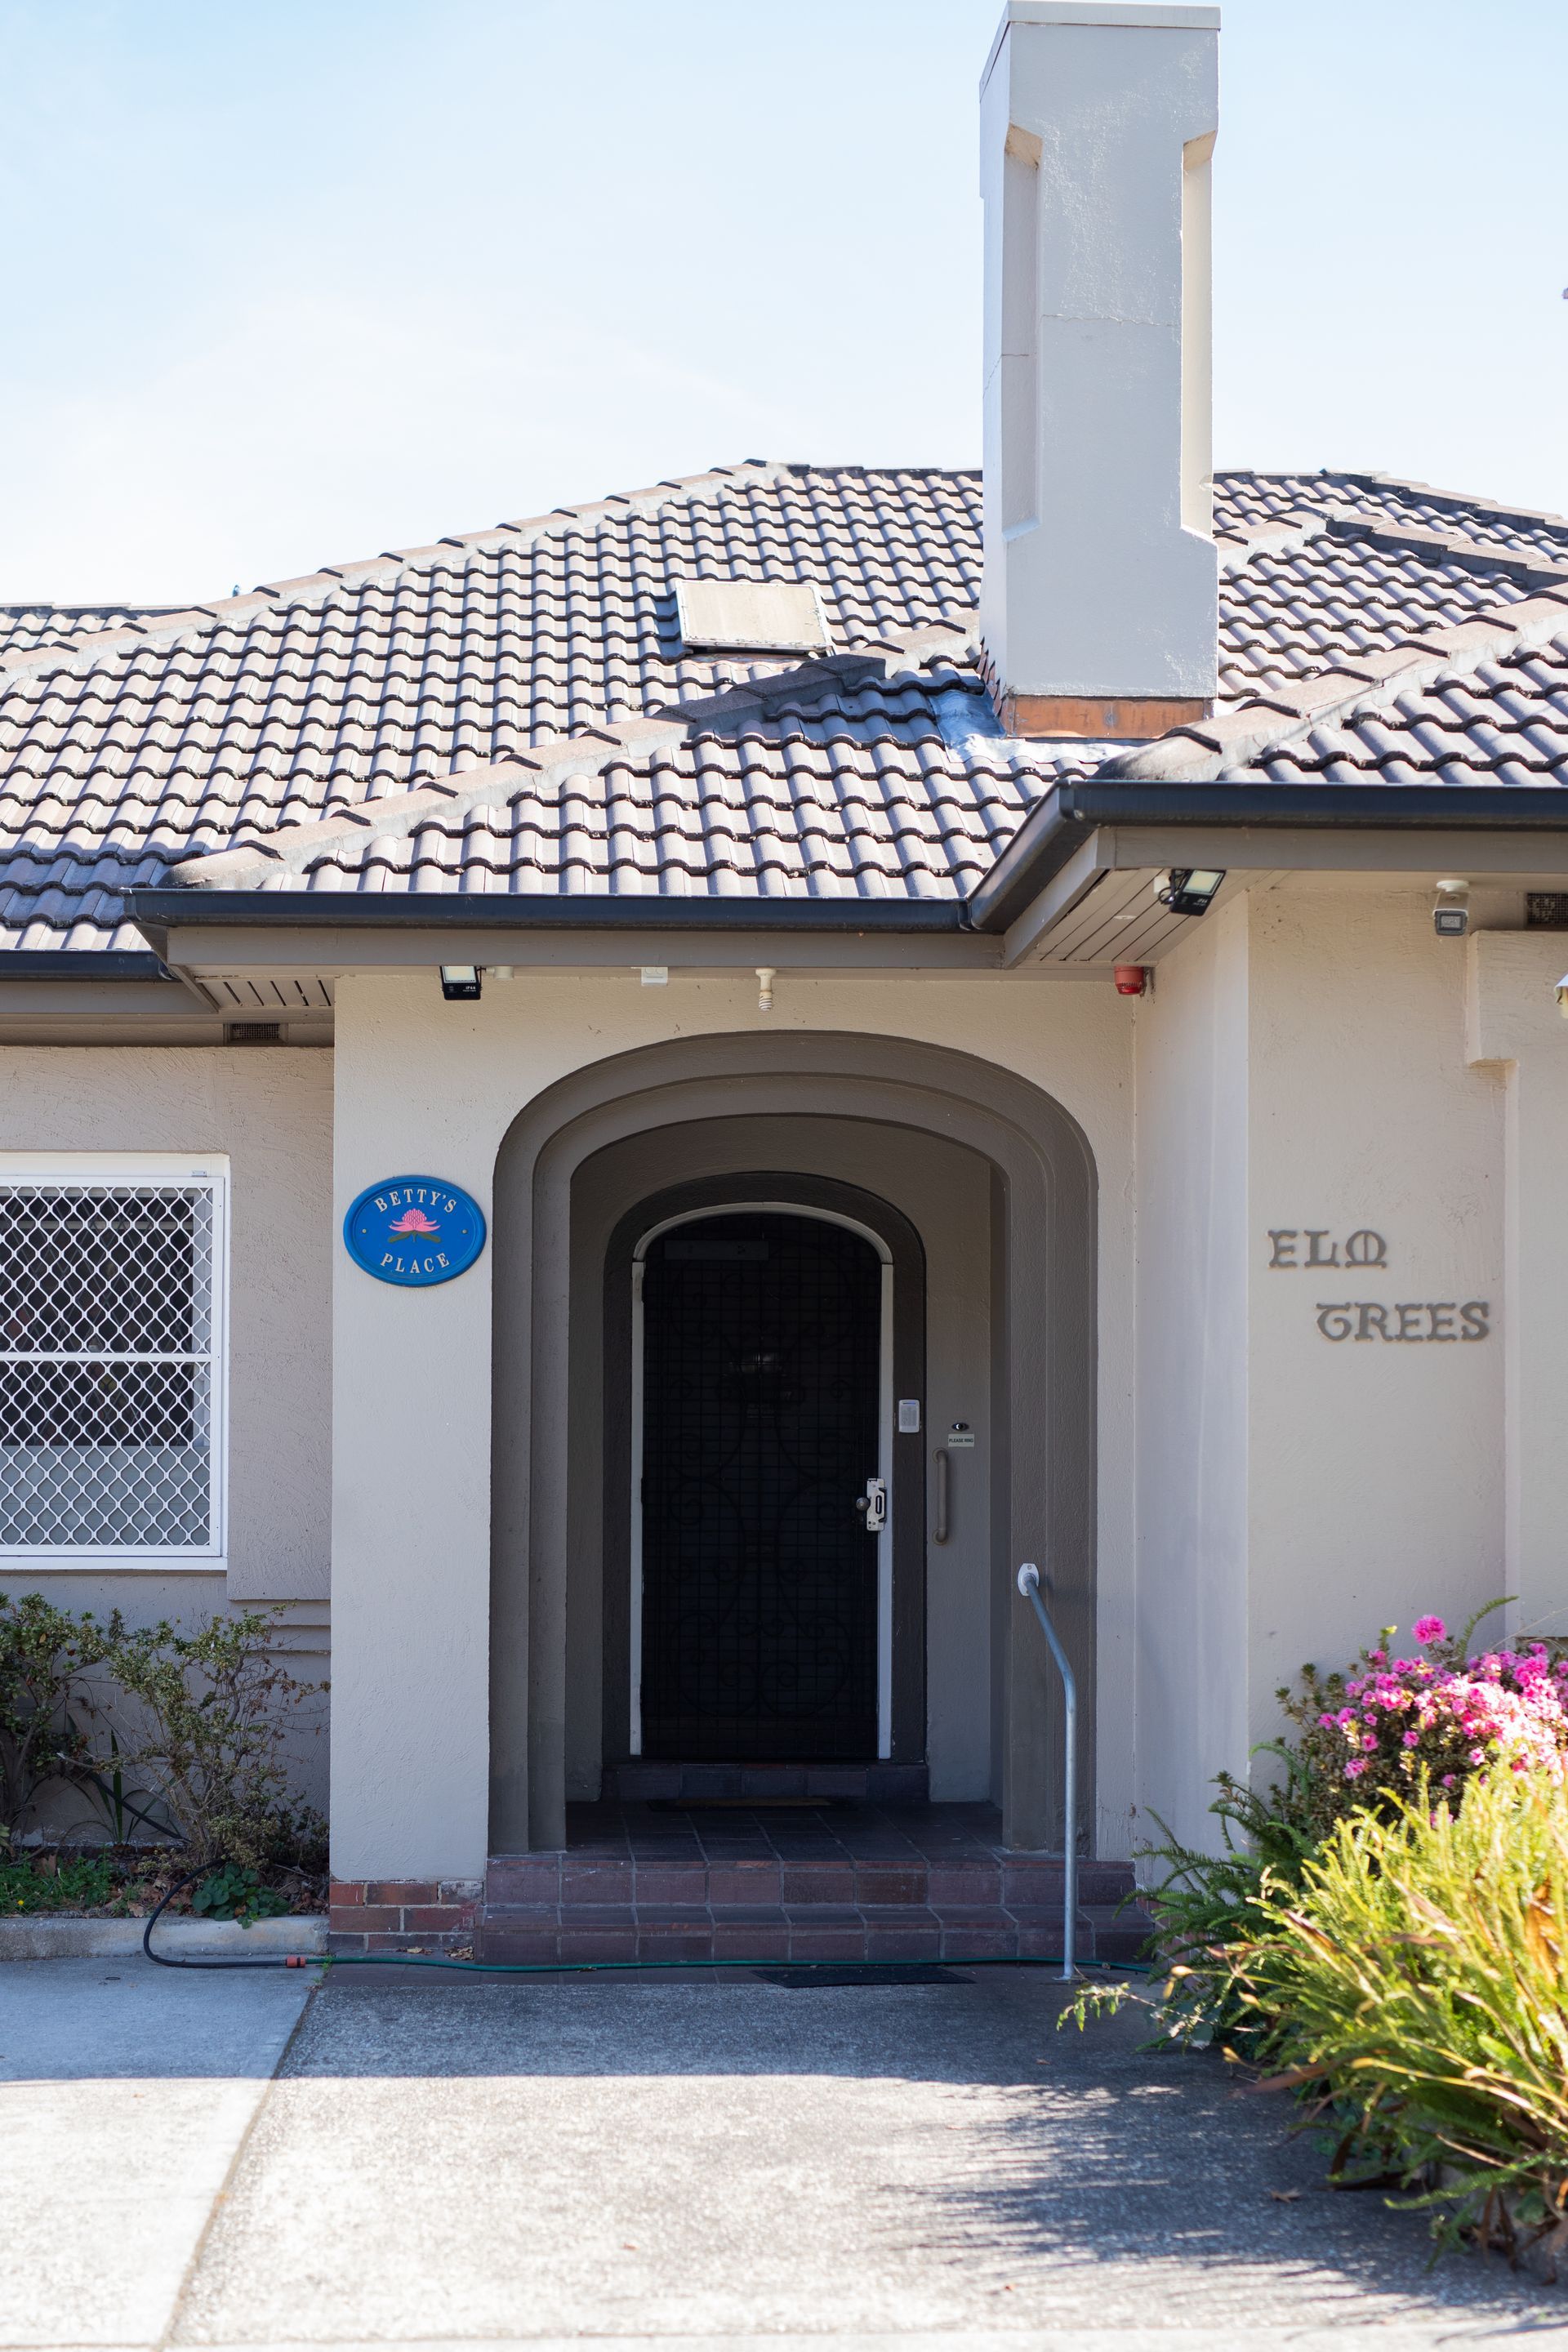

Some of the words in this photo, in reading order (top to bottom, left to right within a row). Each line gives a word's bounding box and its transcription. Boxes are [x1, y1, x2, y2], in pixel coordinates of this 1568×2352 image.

[374, 1189, 457, 1213] BETTY'S
[380, 1253, 450, 1274] PLACE
[1316, 1301, 1490, 1342] TREES
